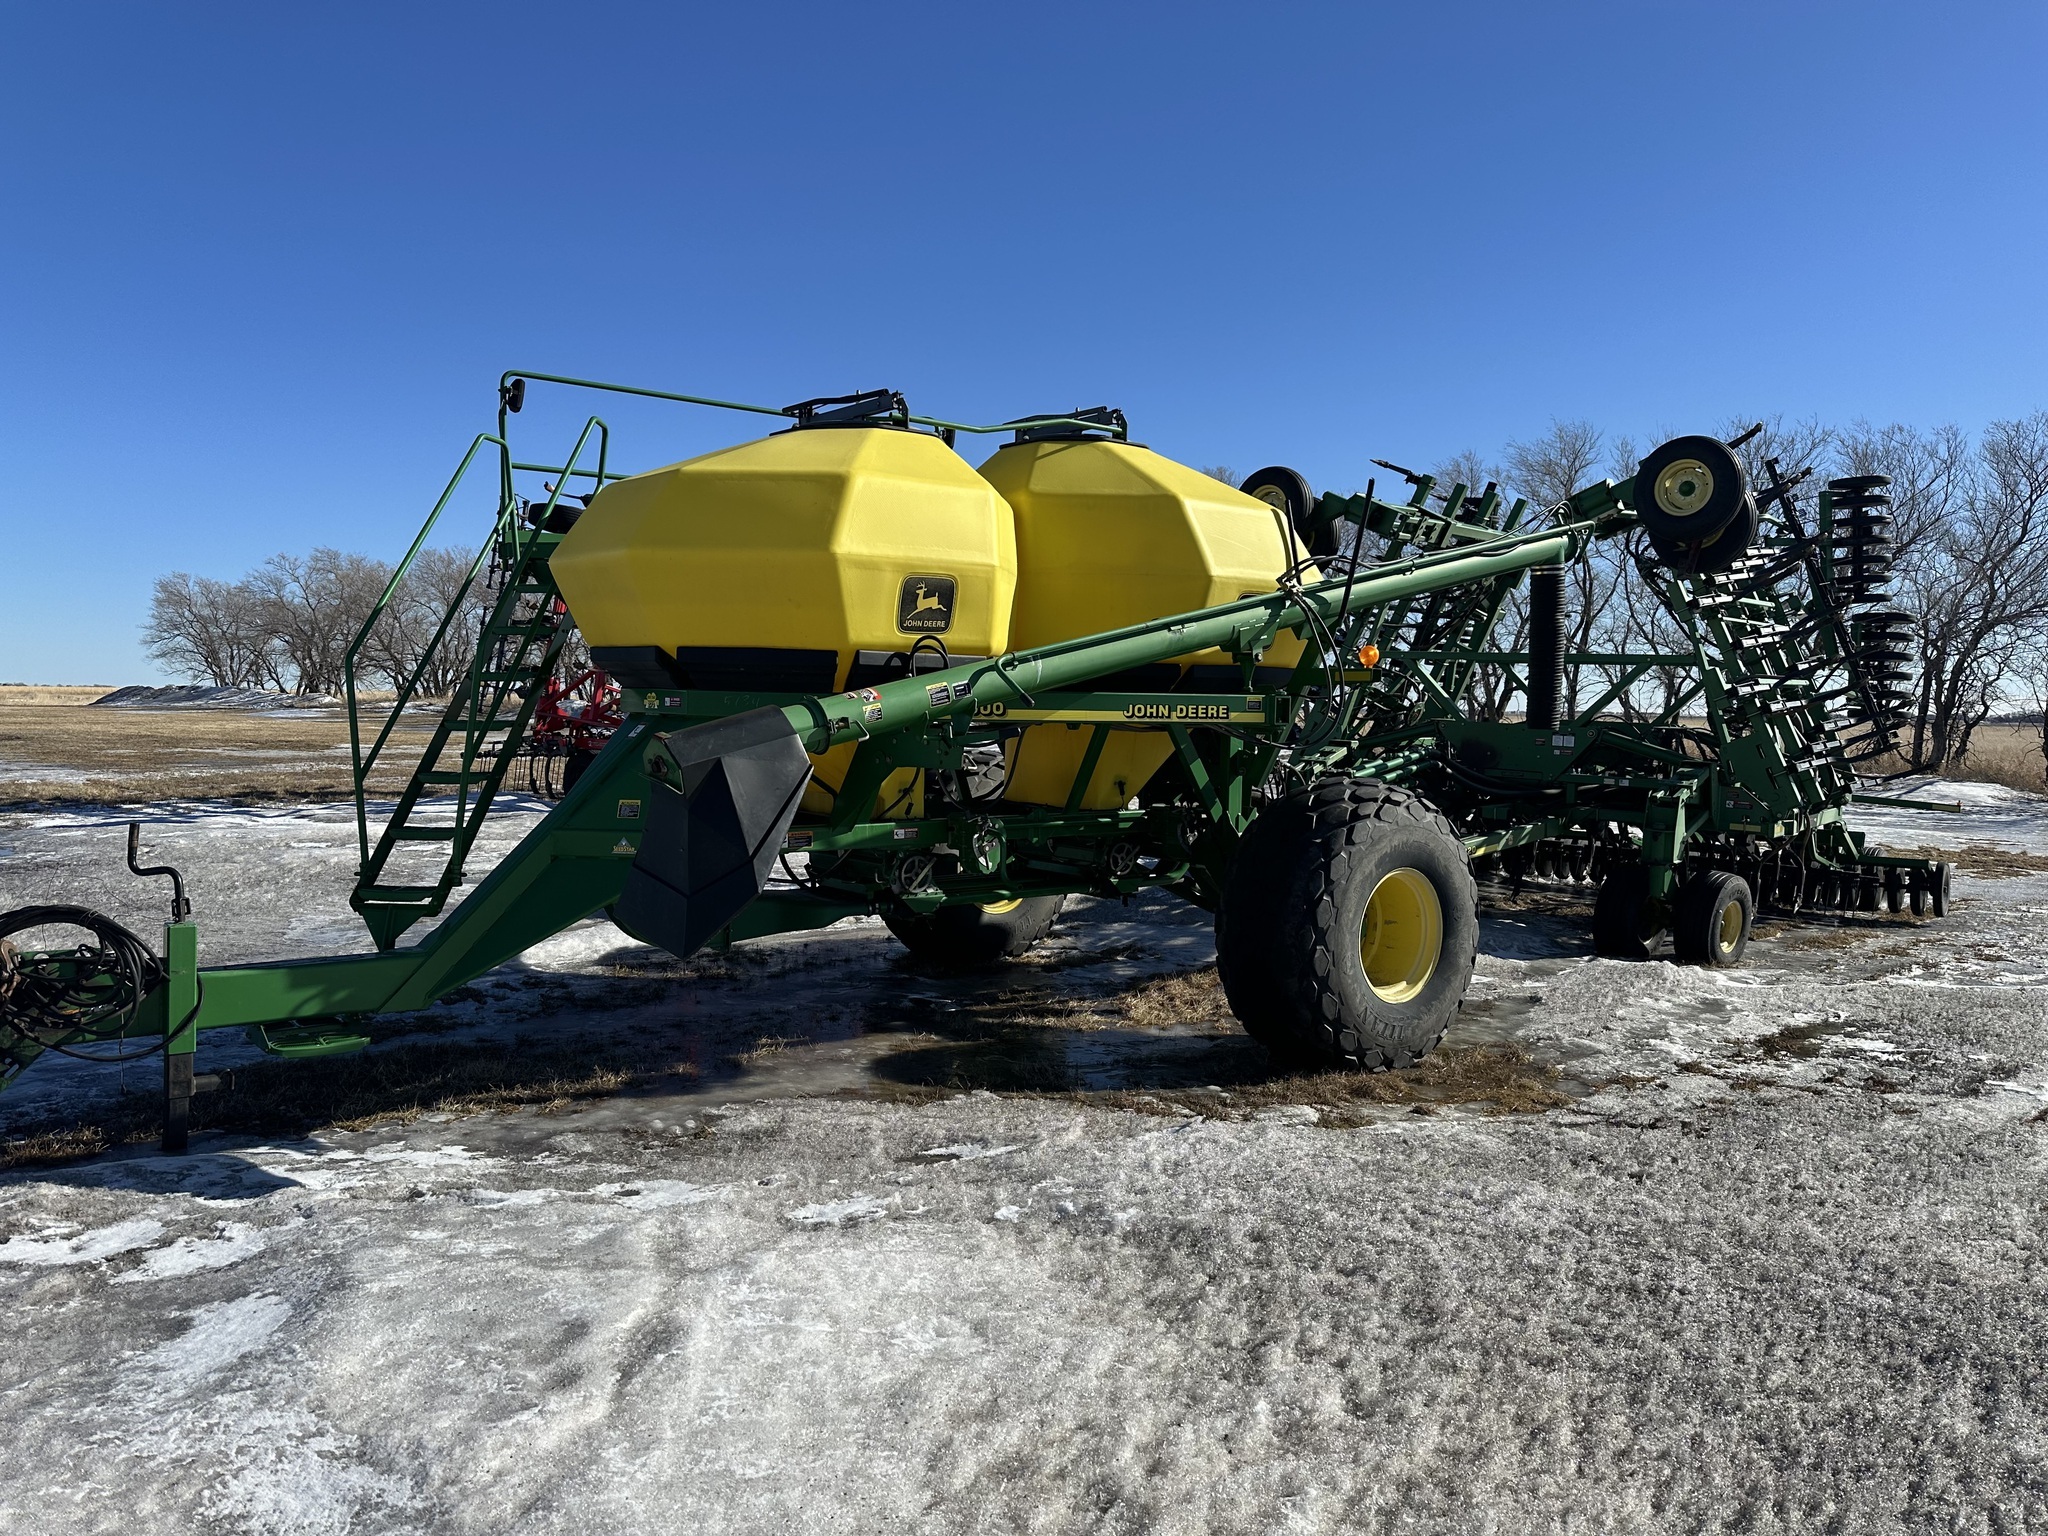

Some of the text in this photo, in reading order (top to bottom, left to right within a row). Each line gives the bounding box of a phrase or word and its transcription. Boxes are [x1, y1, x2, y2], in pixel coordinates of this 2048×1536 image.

[923, 620, 946, 628] DEERE
[1123, 704, 1228, 719] JOHN DEERE
[1356, 1006, 1405, 1042] TITAN
